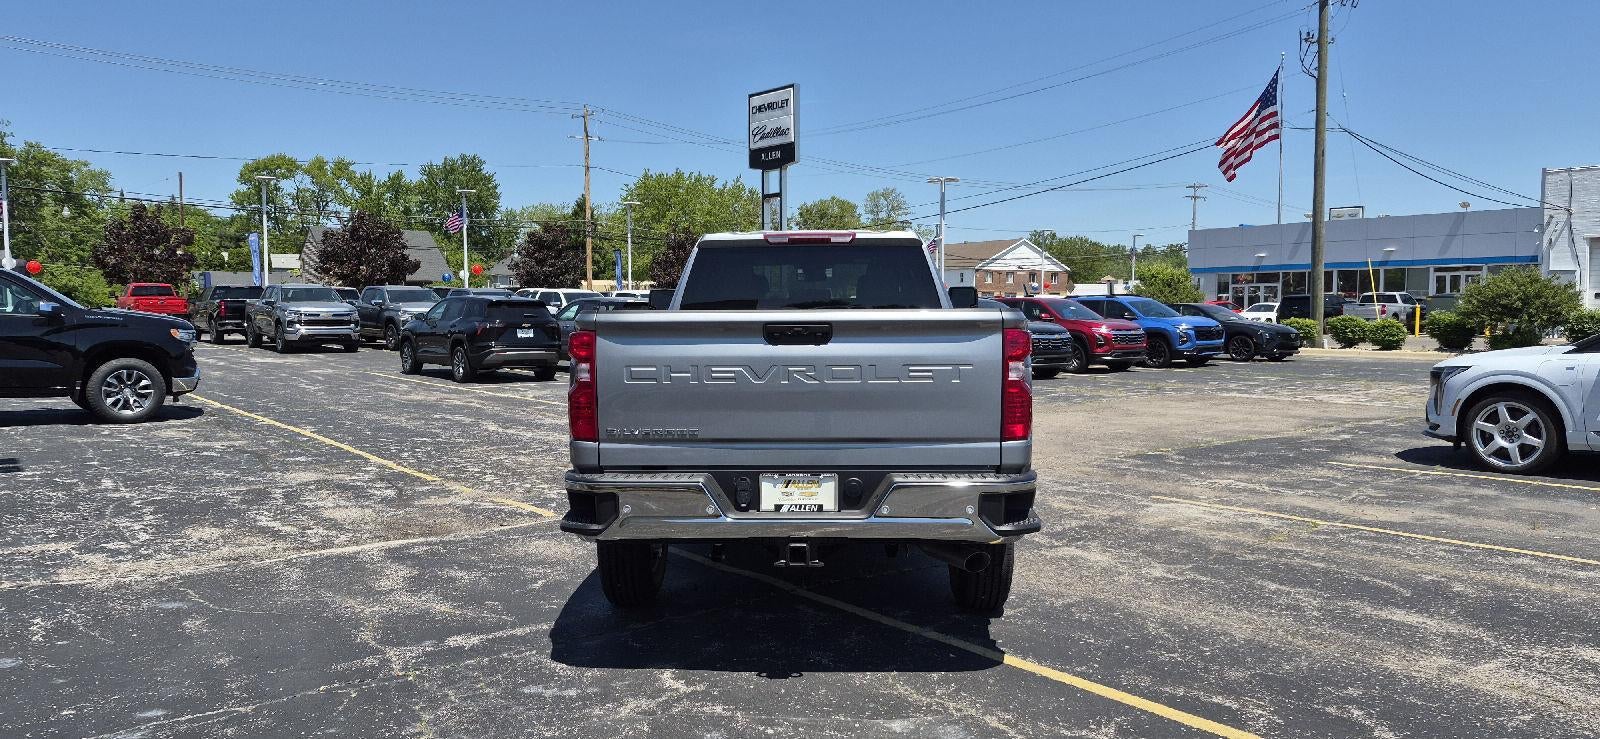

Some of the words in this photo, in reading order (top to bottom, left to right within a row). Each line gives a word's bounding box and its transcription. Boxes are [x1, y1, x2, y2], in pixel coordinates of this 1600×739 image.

[751, 98, 790, 115] CHEVROLET
[751, 124, 791, 144] Cadillac
[761, 150, 781, 161] ALLEN
[623, 364, 974, 384] CHEVROLET
[789, 504, 818, 512] ALLEN
